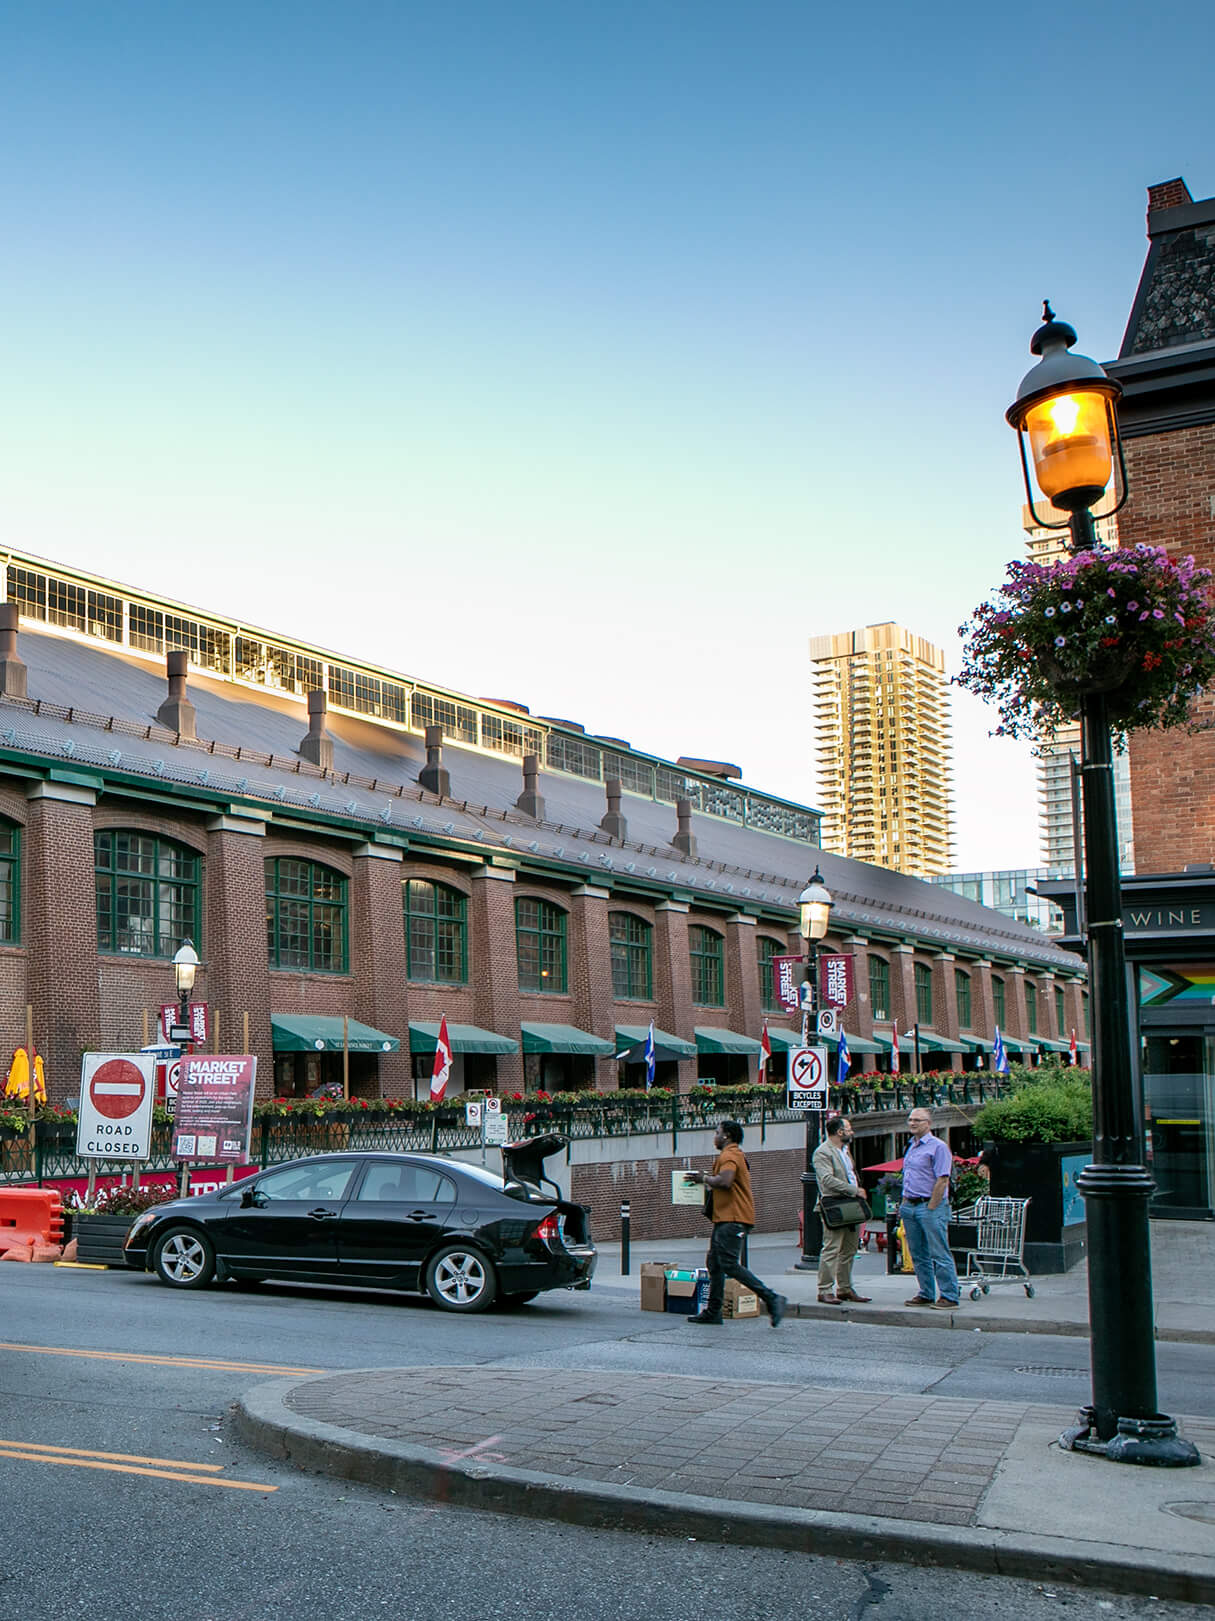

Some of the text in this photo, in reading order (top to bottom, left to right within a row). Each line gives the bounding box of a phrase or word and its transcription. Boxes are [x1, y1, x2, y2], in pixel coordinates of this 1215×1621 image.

[1130, 909, 1201, 926] WINE
[779, 962, 790, 1002] STREET
[827, 961, 838, 1001] STREET
[837, 961, 847, 1006] MARKET
[189, 1061, 247, 1073] MARKET
[188, 1073, 240, 1085] STREET
[793, 1091, 822, 1100] BICYCLES
[792, 1100, 823, 1109] EXCEPTED
[96, 1124, 133, 1136] ROAD
[87, 1141, 140, 1153] CLOSED
